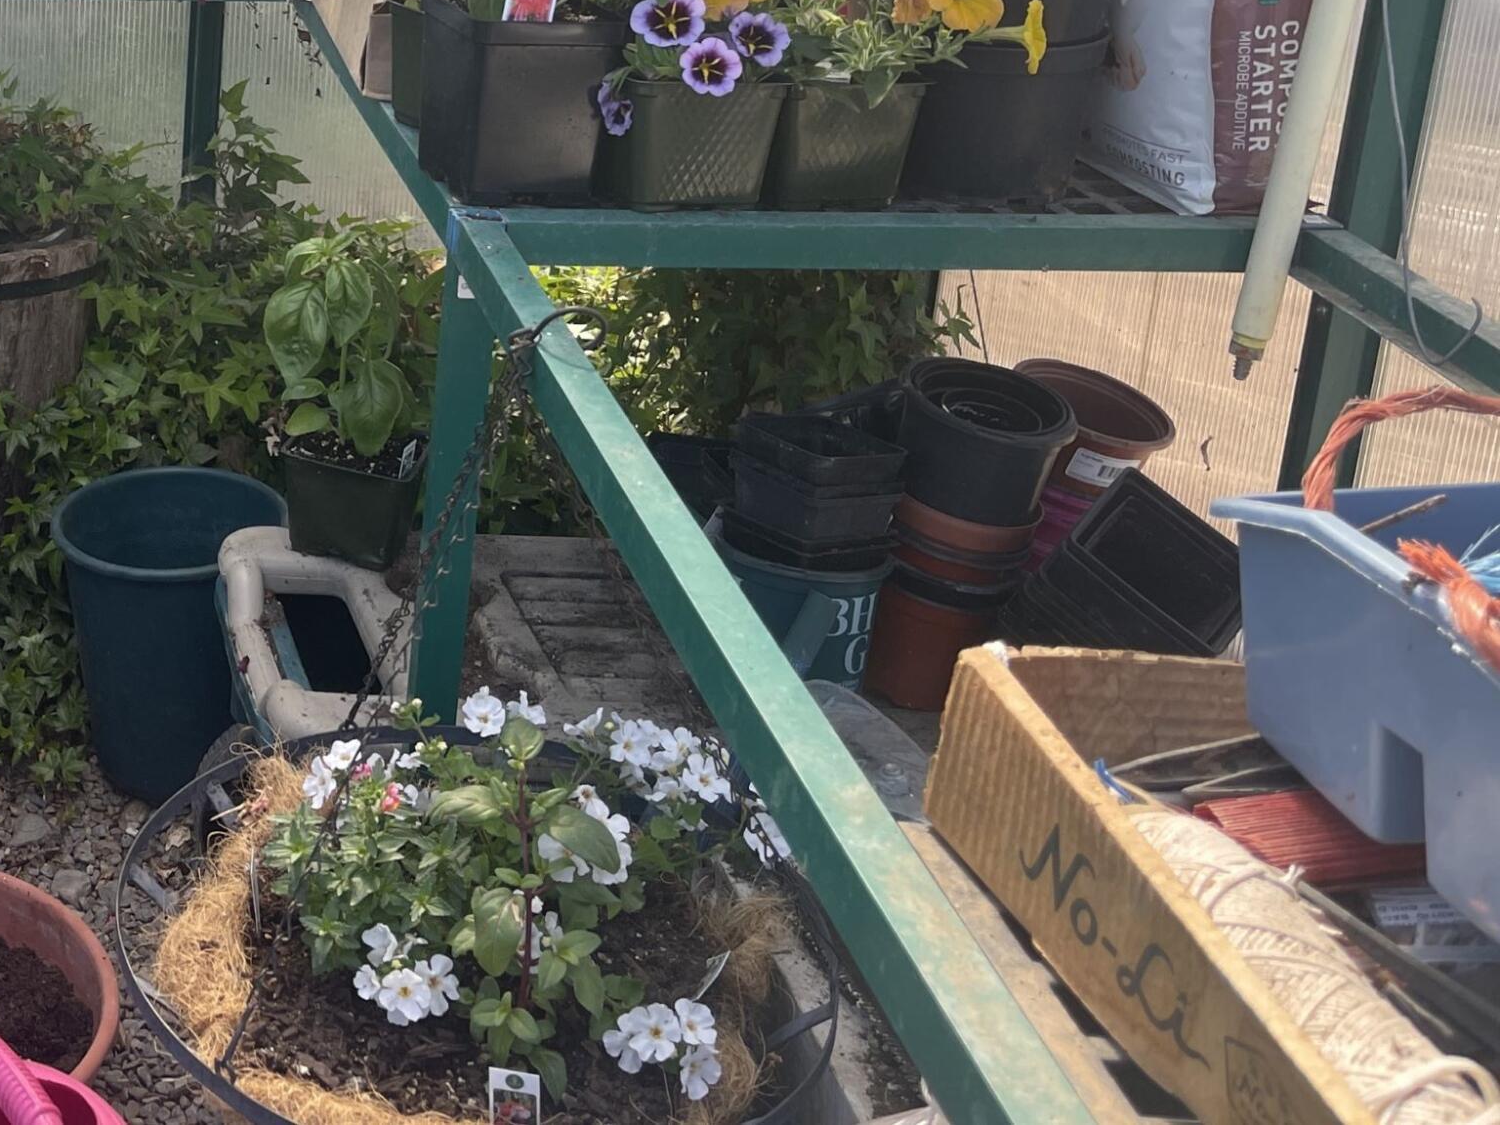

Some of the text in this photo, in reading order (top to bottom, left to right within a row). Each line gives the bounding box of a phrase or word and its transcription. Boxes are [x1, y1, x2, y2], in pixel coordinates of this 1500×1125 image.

[1231, 29, 1252, 150] MICROBE ADDITIVE
[1248, 24, 1277, 152] STARTER
[1150, 148, 1185, 164] FAST
[1018, 823, 1211, 1072] No-Li
